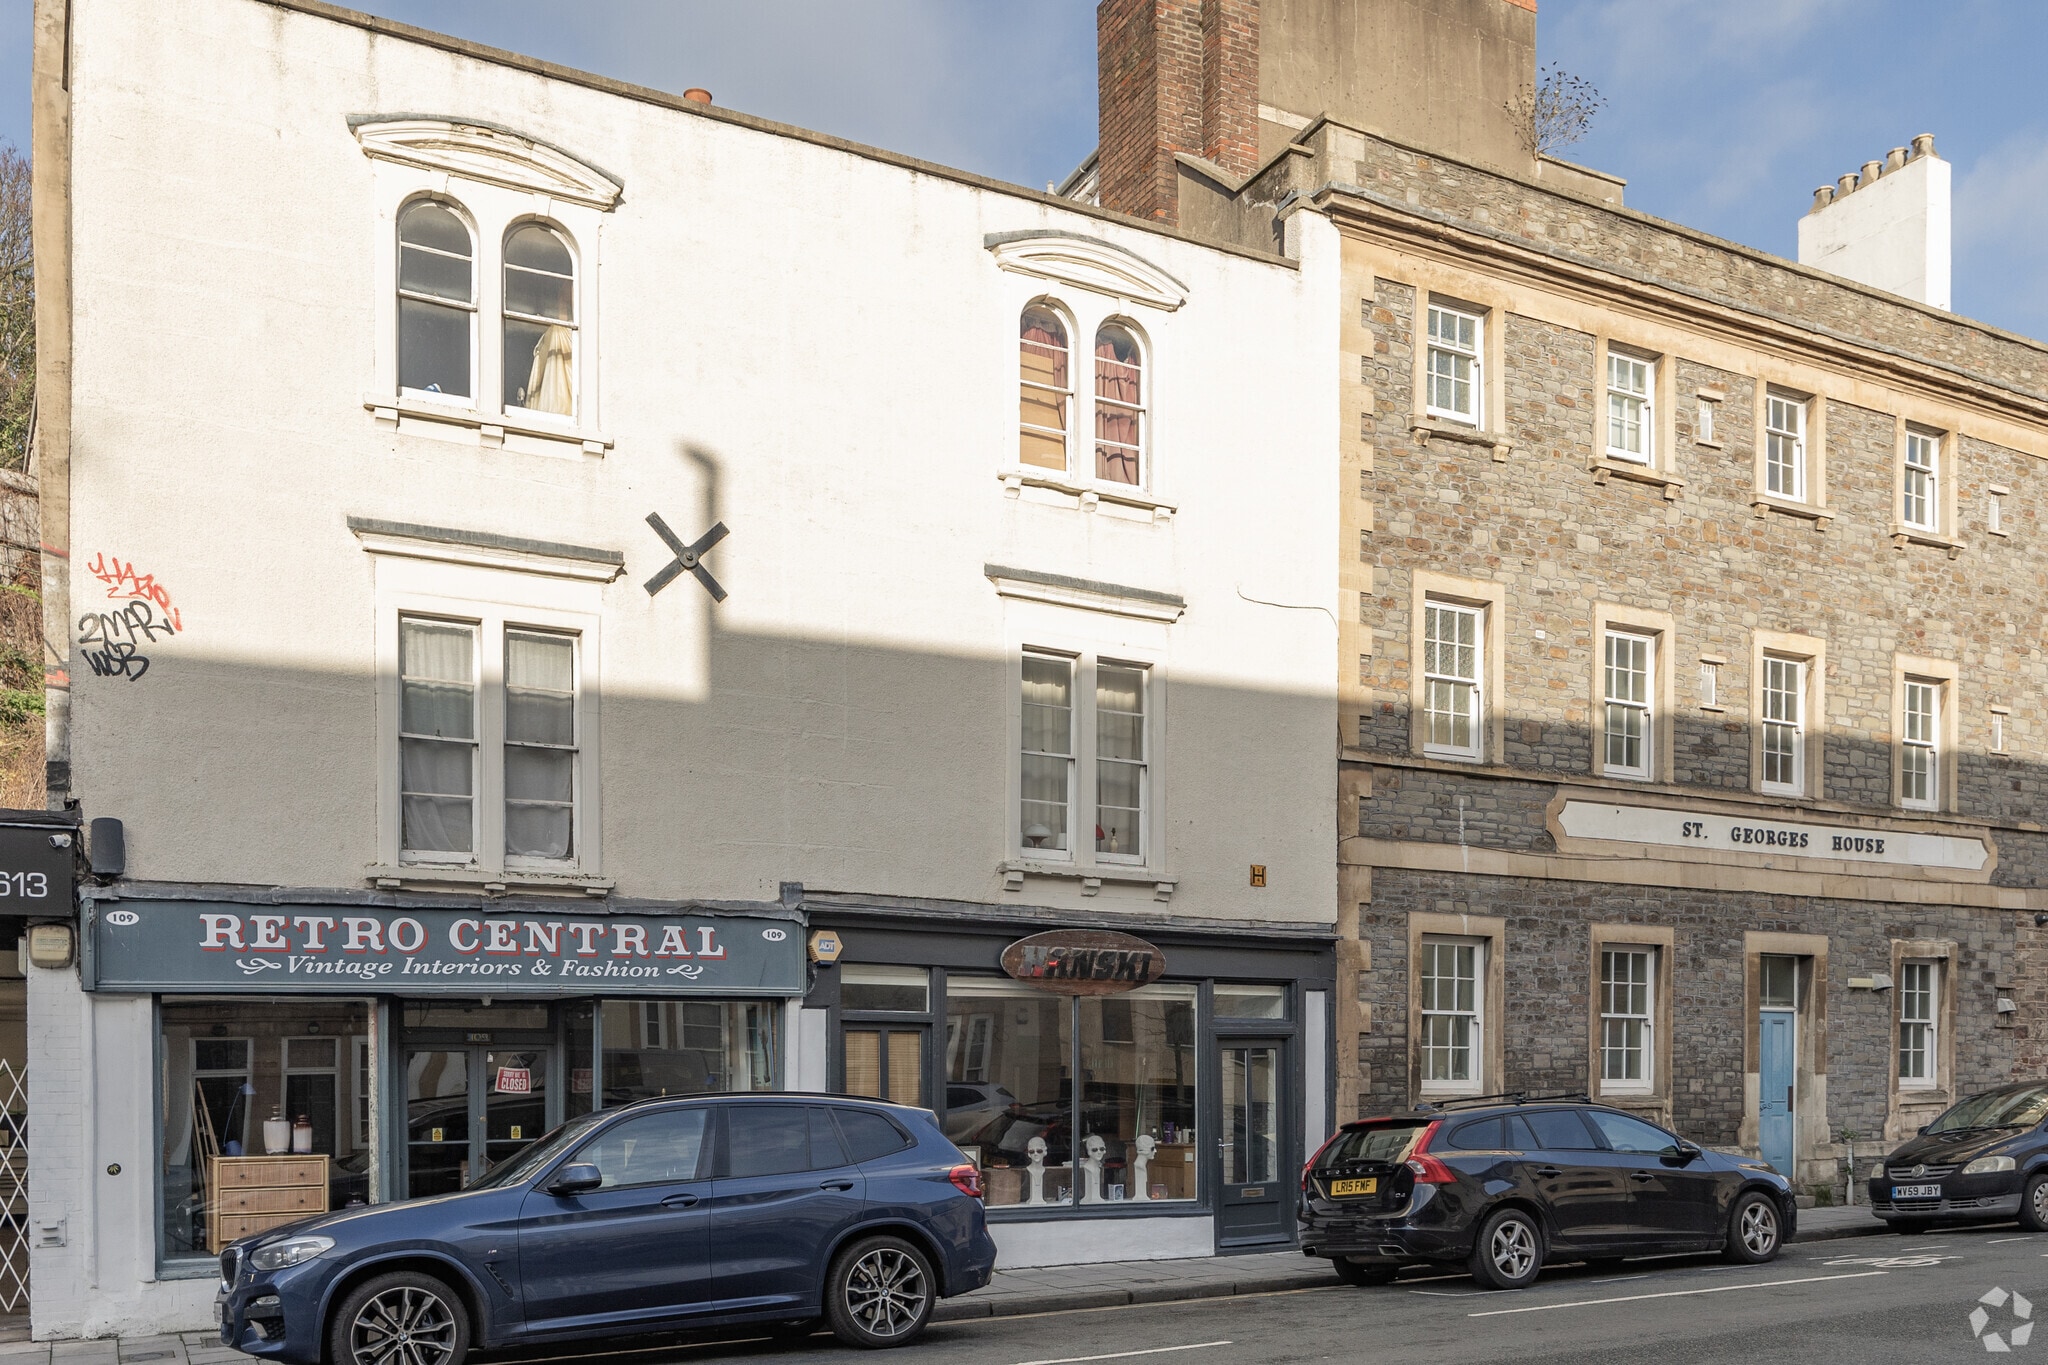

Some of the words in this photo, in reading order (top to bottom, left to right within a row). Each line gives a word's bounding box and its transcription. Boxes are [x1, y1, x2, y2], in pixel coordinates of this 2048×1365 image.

[1682, 821, 1709, 839] ST.
[1731, 826, 1809, 848] GEORGES
[1832, 836, 1885, 854] HOUSE
[1252, 867, 1265, 884] H
[112, 913, 135, 924] 109
[199, 913, 429, 955] RETRO
[448, 918, 727, 960] CENTRAL
[766, 931, 783, 940] 109
[819, 941, 835, 950] ADT
[288, 955, 393, 980] Vintage
[401, 956, 522, 977] Interiors
[530, 958, 552, 976] &
[559, 959, 660, 978] Fashion
[501, 1077, 527, 1091] CLOSED
[1336, 1180, 1353, 1193] LR15
[1897, 1187, 1919, 1198] WV59
[1921, 1185, 1939, 1196] JBY
